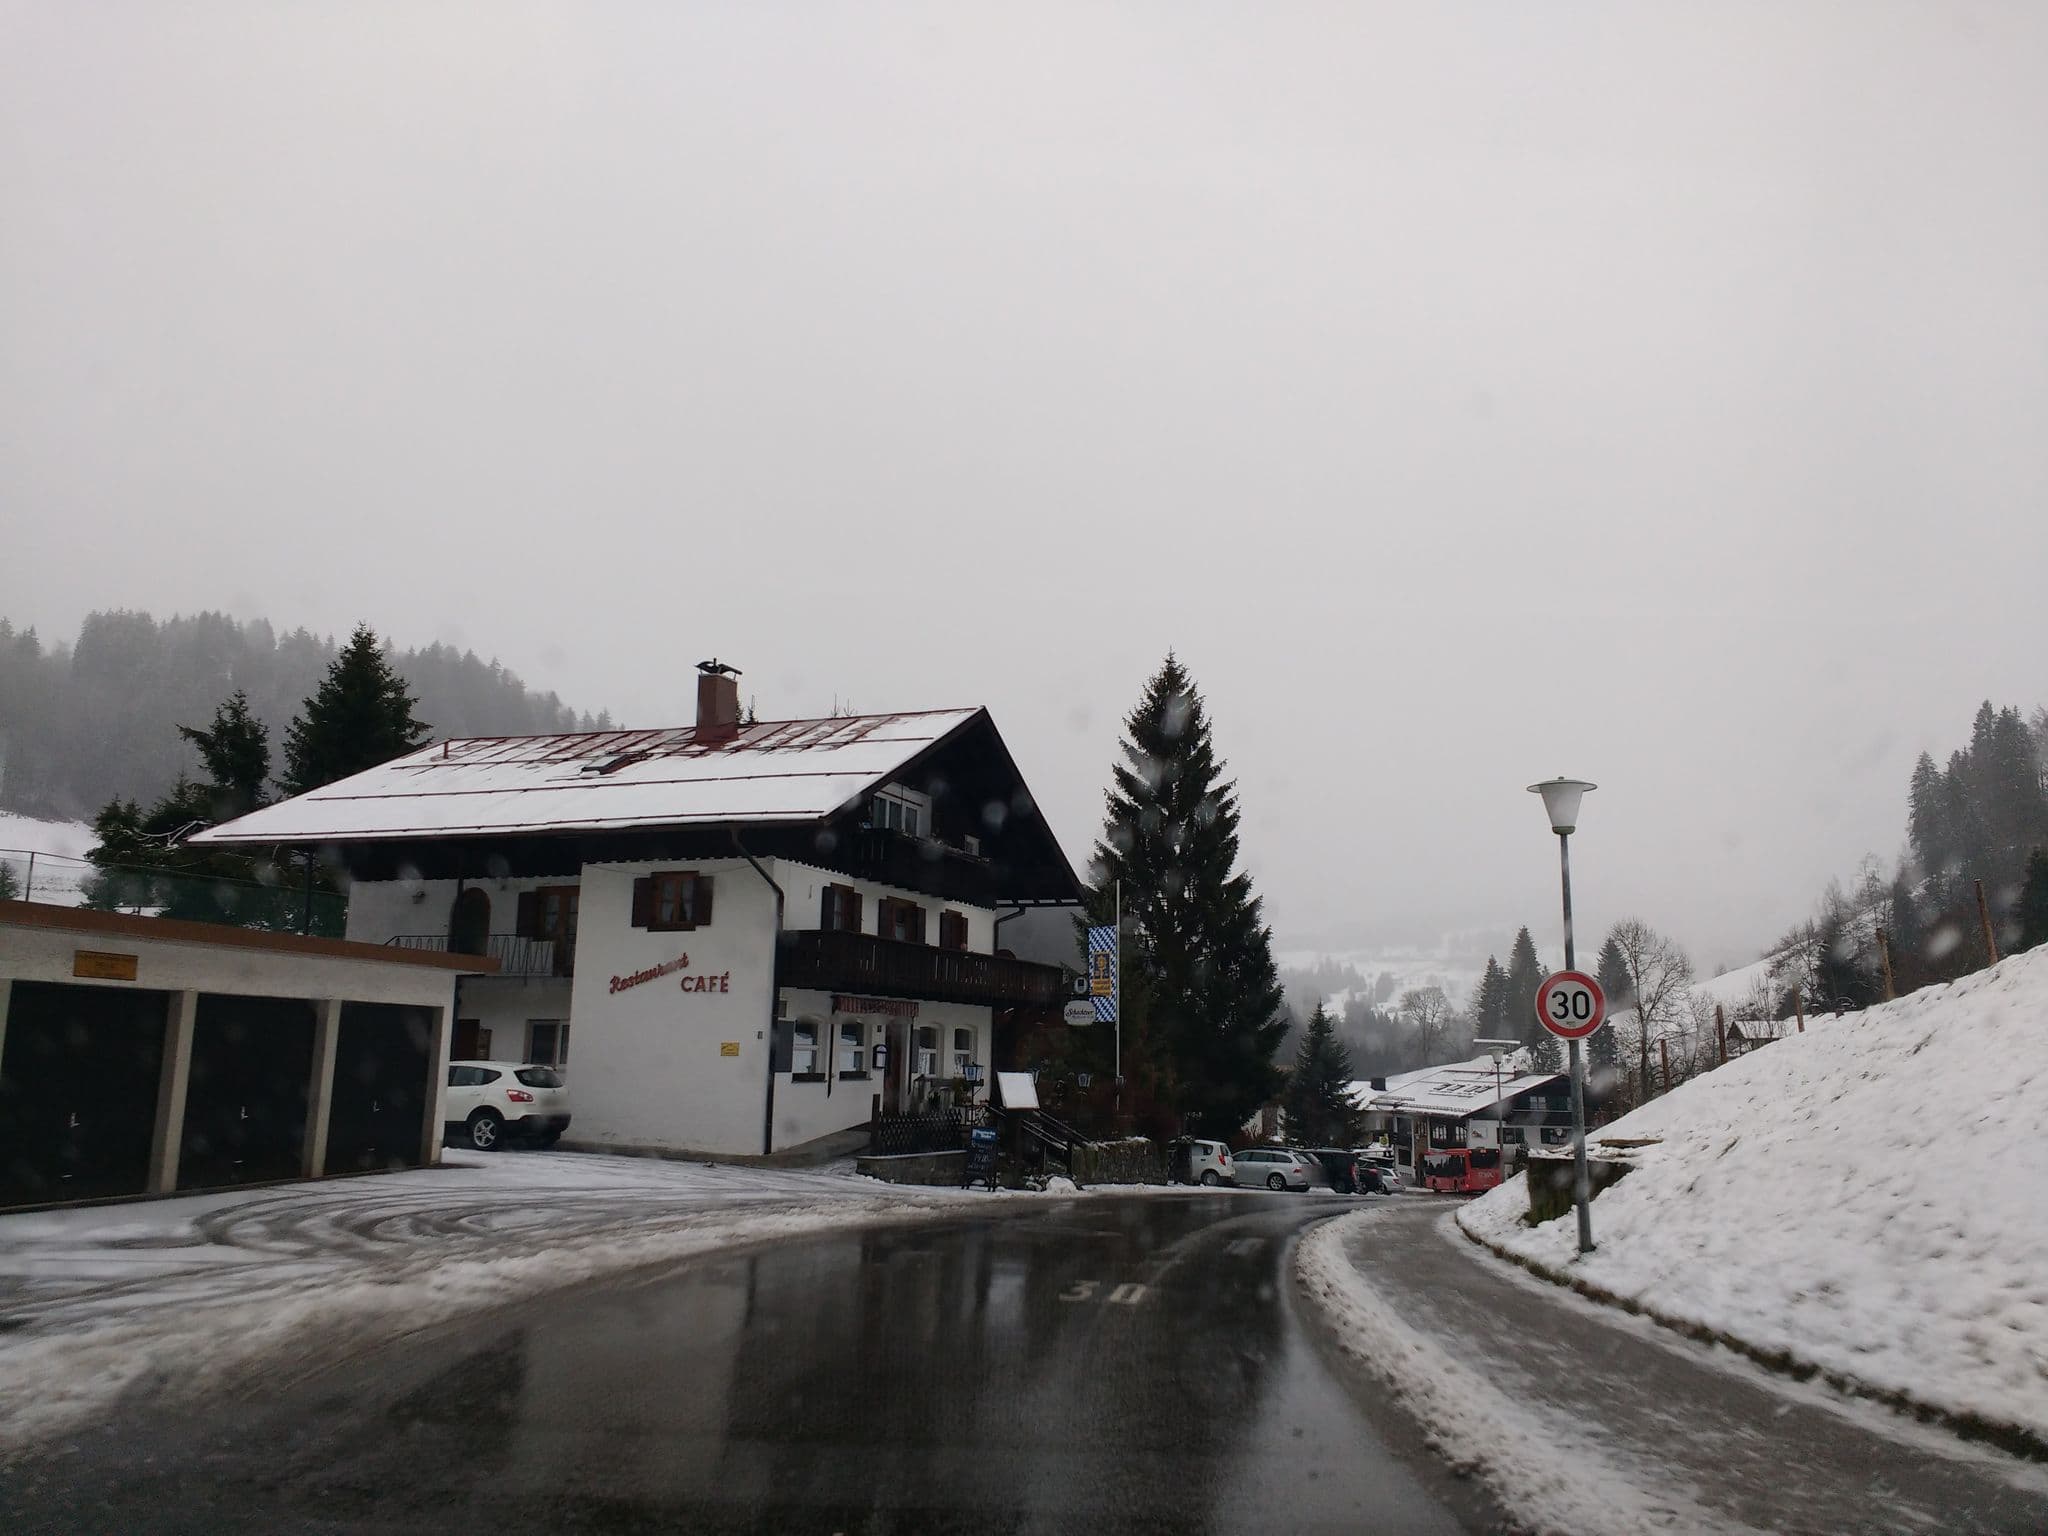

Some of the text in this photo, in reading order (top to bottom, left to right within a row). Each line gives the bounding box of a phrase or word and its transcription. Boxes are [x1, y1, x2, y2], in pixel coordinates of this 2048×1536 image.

[609, 952, 689, 995] Restaurant
[681, 971, 729, 993] CAFÉ
[1552, 990, 1590, 1020] 30
[1059, 1280, 1147, 1304] 30
